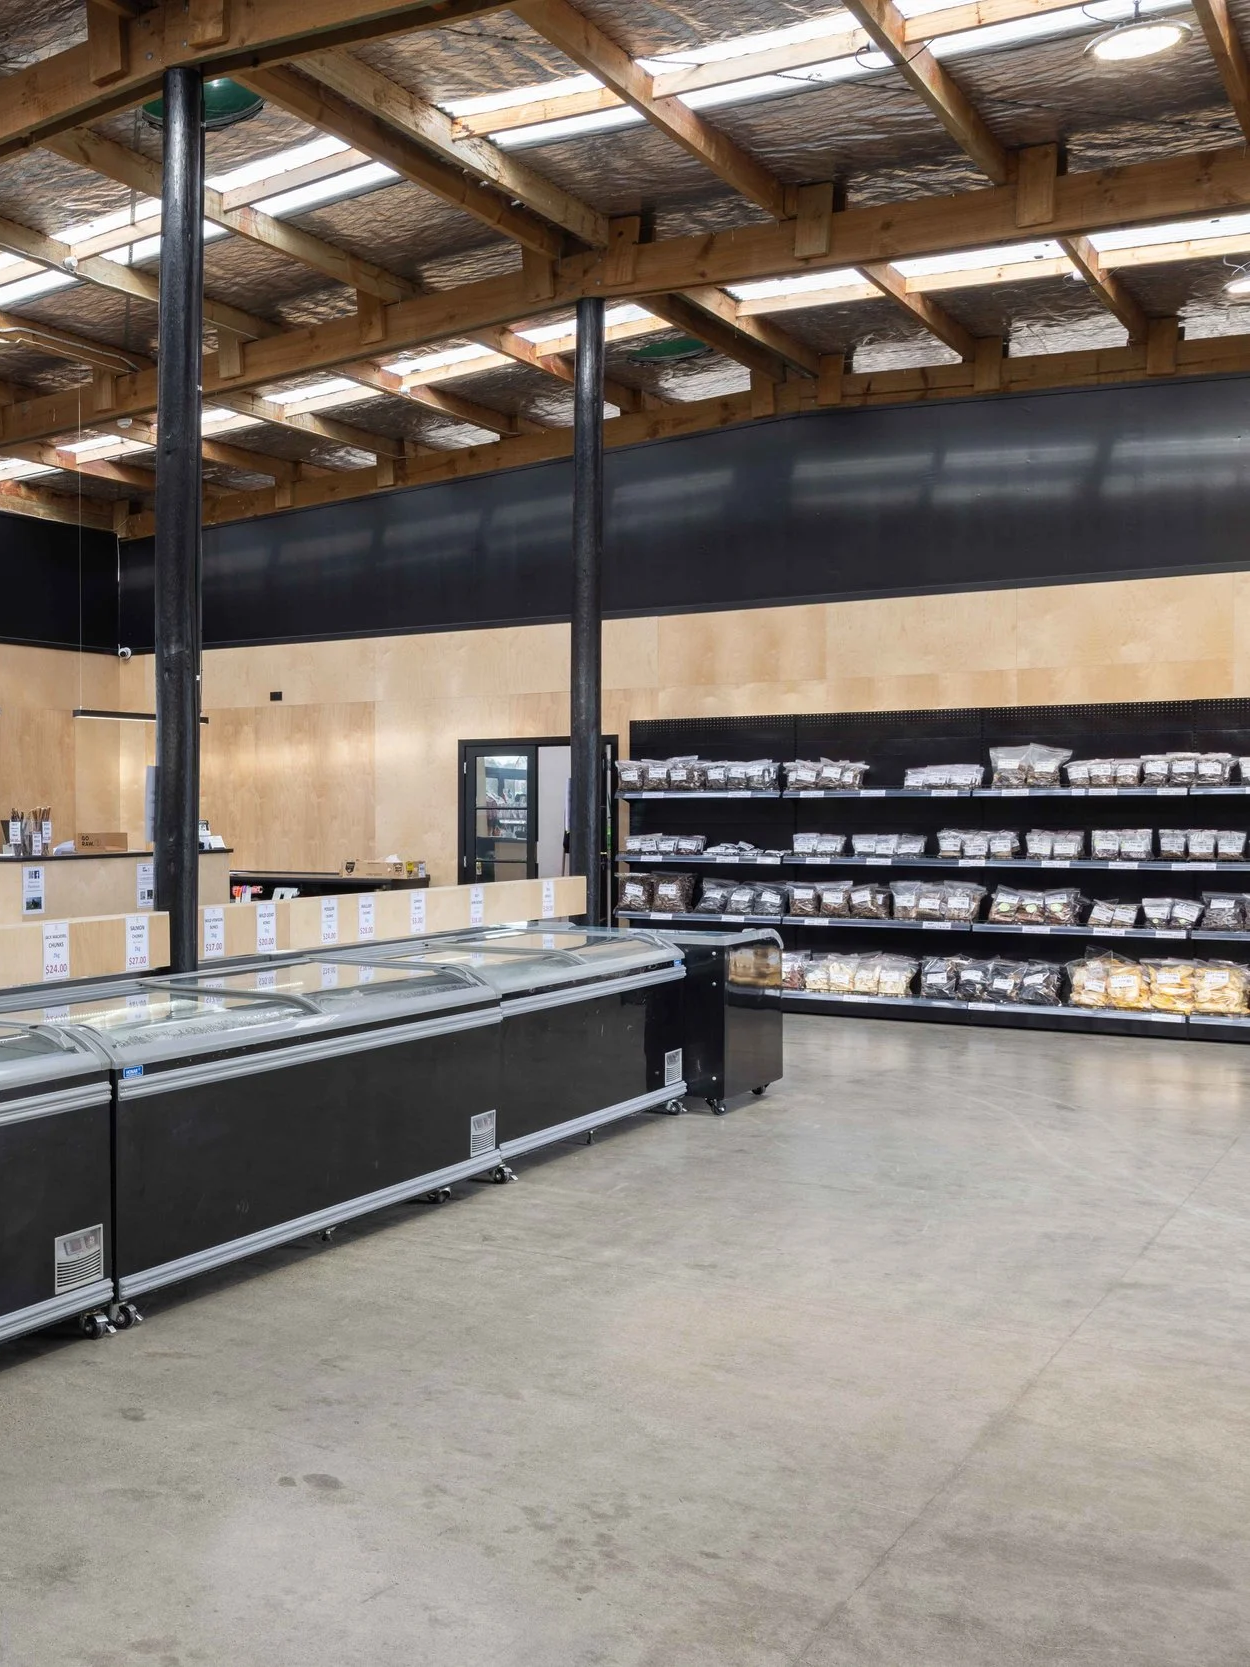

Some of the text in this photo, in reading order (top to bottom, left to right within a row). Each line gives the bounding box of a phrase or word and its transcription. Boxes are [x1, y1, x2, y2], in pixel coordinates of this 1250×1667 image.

[48, 941, 64, 949] CHUNKS
[205, 942, 223, 952] $17.00
[128, 955, 147, 966] $27.00
[45, 963, 68, 975] $24.00
